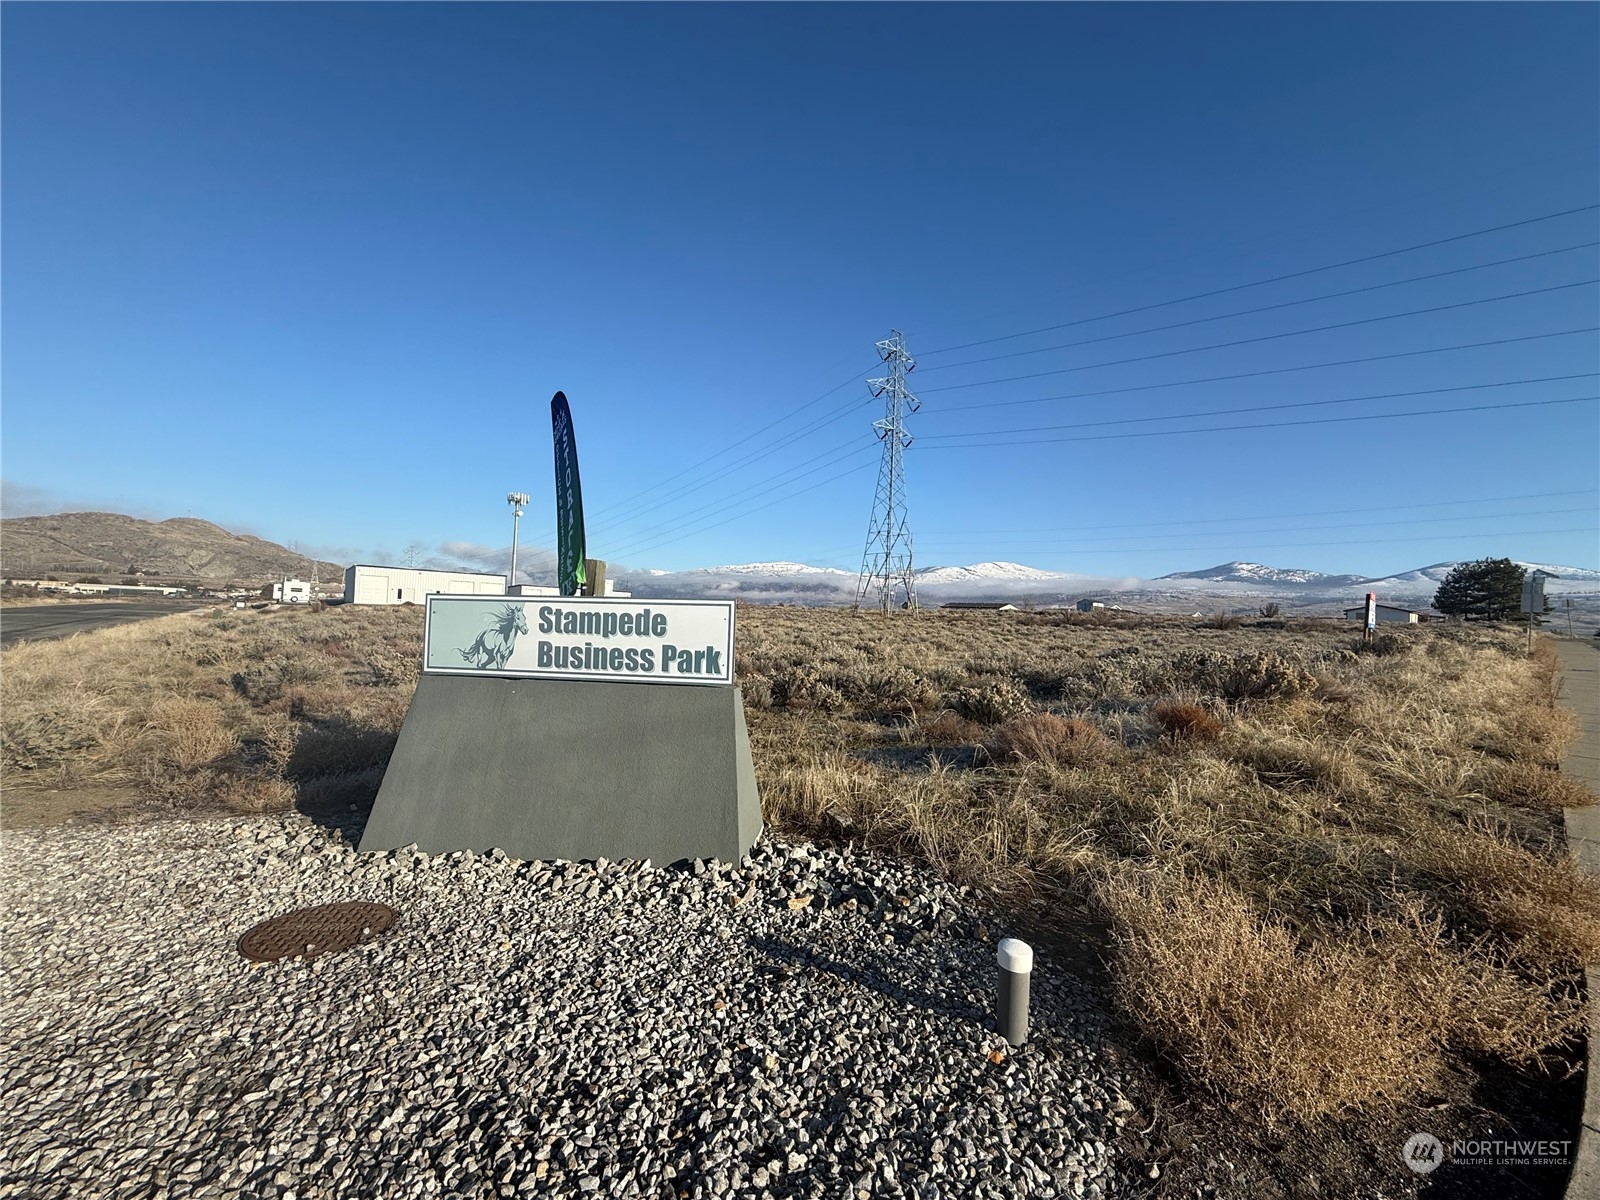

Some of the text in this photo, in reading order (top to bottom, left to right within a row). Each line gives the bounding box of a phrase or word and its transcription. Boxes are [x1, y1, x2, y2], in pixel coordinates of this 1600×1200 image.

[538, 605, 667, 637] Stampede
[537, 642, 723, 674] Business Park
